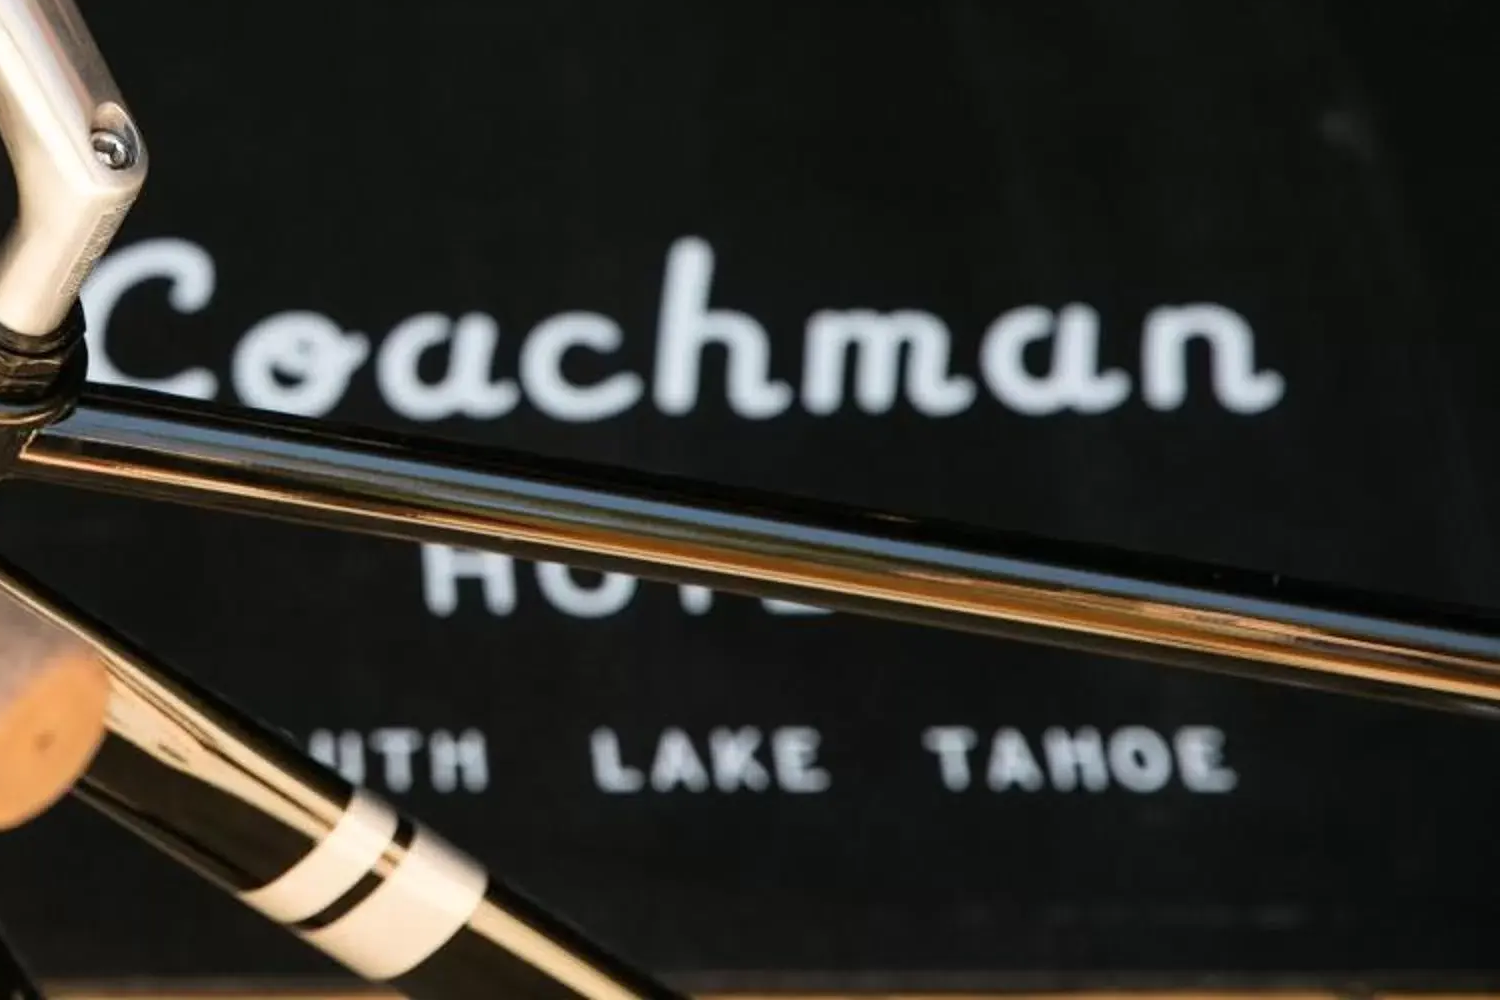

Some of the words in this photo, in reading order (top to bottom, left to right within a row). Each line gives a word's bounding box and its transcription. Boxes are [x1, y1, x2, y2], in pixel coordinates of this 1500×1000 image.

[86, 237, 1283, 420] Coachman
[589, 725, 832, 794] LAKE
[923, 726, 1239, 795] TAHOE
